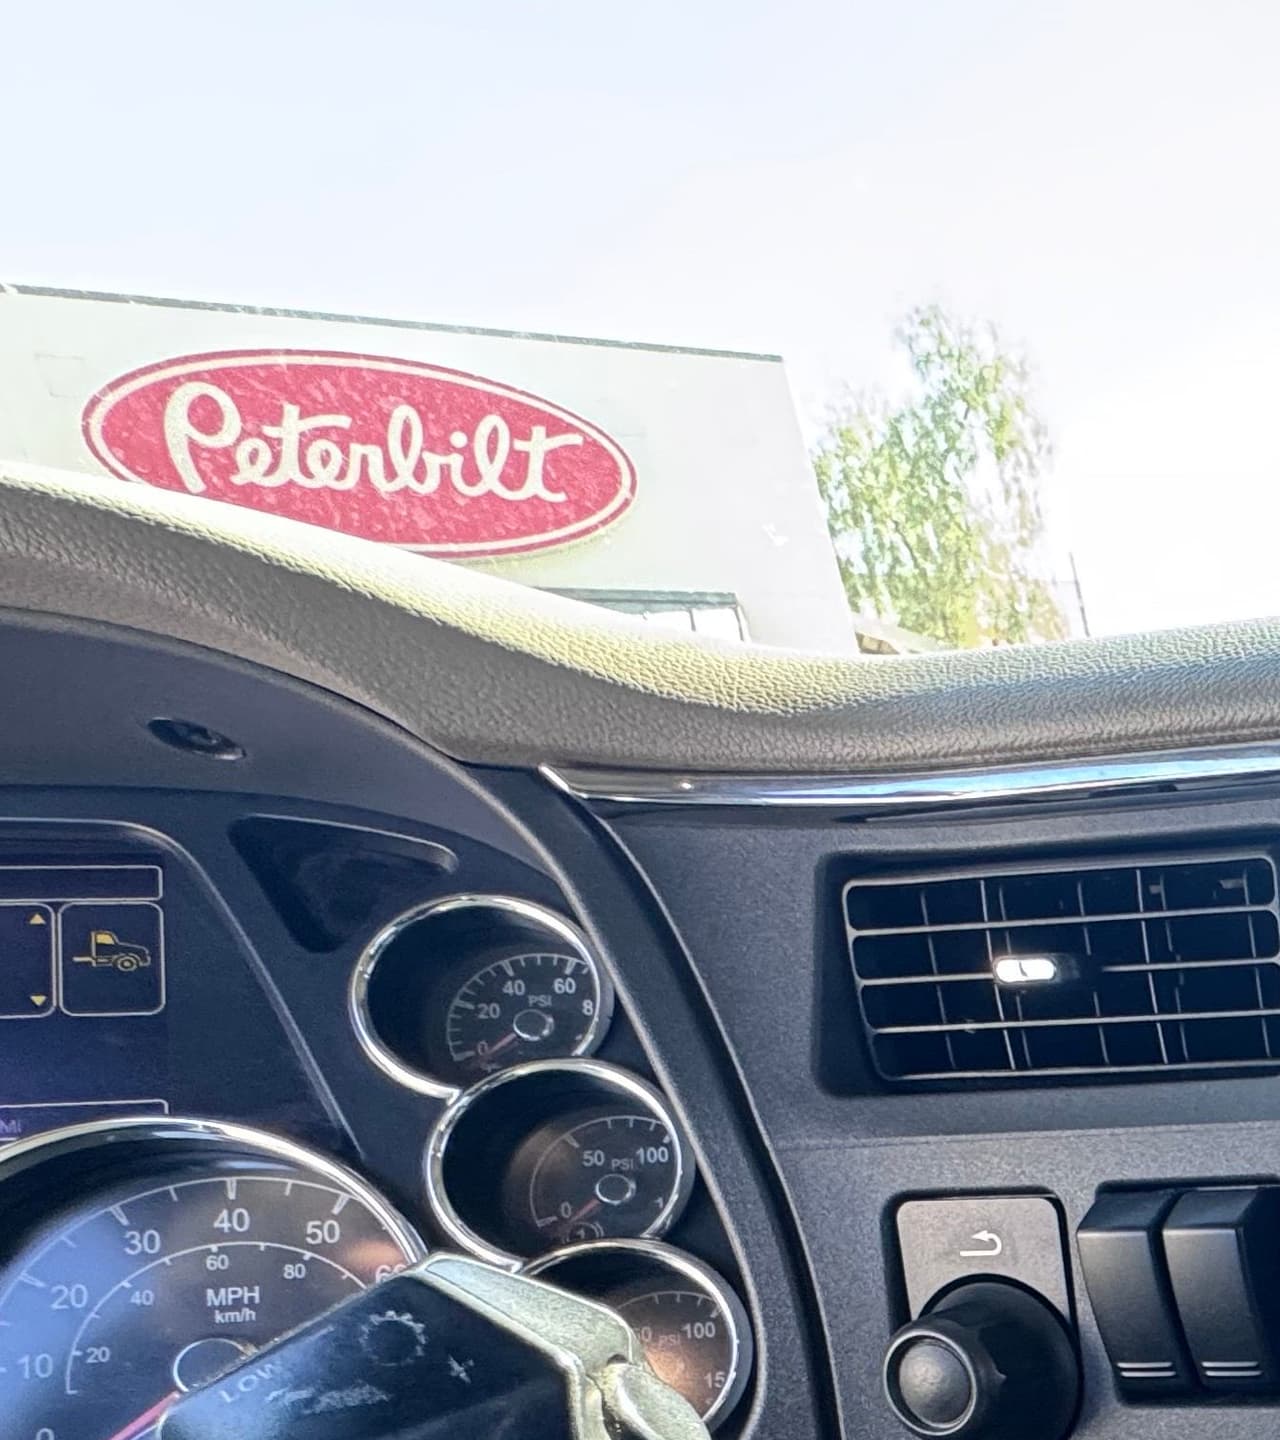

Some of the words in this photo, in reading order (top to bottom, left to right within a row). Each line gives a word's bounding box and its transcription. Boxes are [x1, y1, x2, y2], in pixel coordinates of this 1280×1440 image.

[163, 382, 586, 503] Peterbilt
[502, 979, 526, 996] 40
[553, 977, 577, 994] 60
[528, 995, 553, 1007] PSI
[581, 1000, 594, 1016] 8
[477, 1003, 500, 1019] 20
[477, 1041, 489, 1055] 0
[582, 1150, 605, 1167] 50
[636, 1147, 669, 1164] 100
[611, 1159, 634, 1171] PSI
[560, 1202, 572, 1218] 0
[213, 1208, 250, 1233] 40
[305, 1220, 341, 1245] 50
[124, 1230, 161, 1255] 30
[206, 1254, 229, 1271] 60
[283, 1264, 306, 1280] 80
[51, 1285, 88, 1310] 20
[130, 1290, 154, 1305] 40
[206, 1286, 260, 1307] MPH
[214, 1309, 257, 1323] km/h
[681, 1322, 716, 1339] 100
[86, 1347, 110, 1363] 20
[18, 1354, 53, 1379] 10
[219, 1363, 274, 1403] LOW
[703, 1371, 726, 1388] 15
